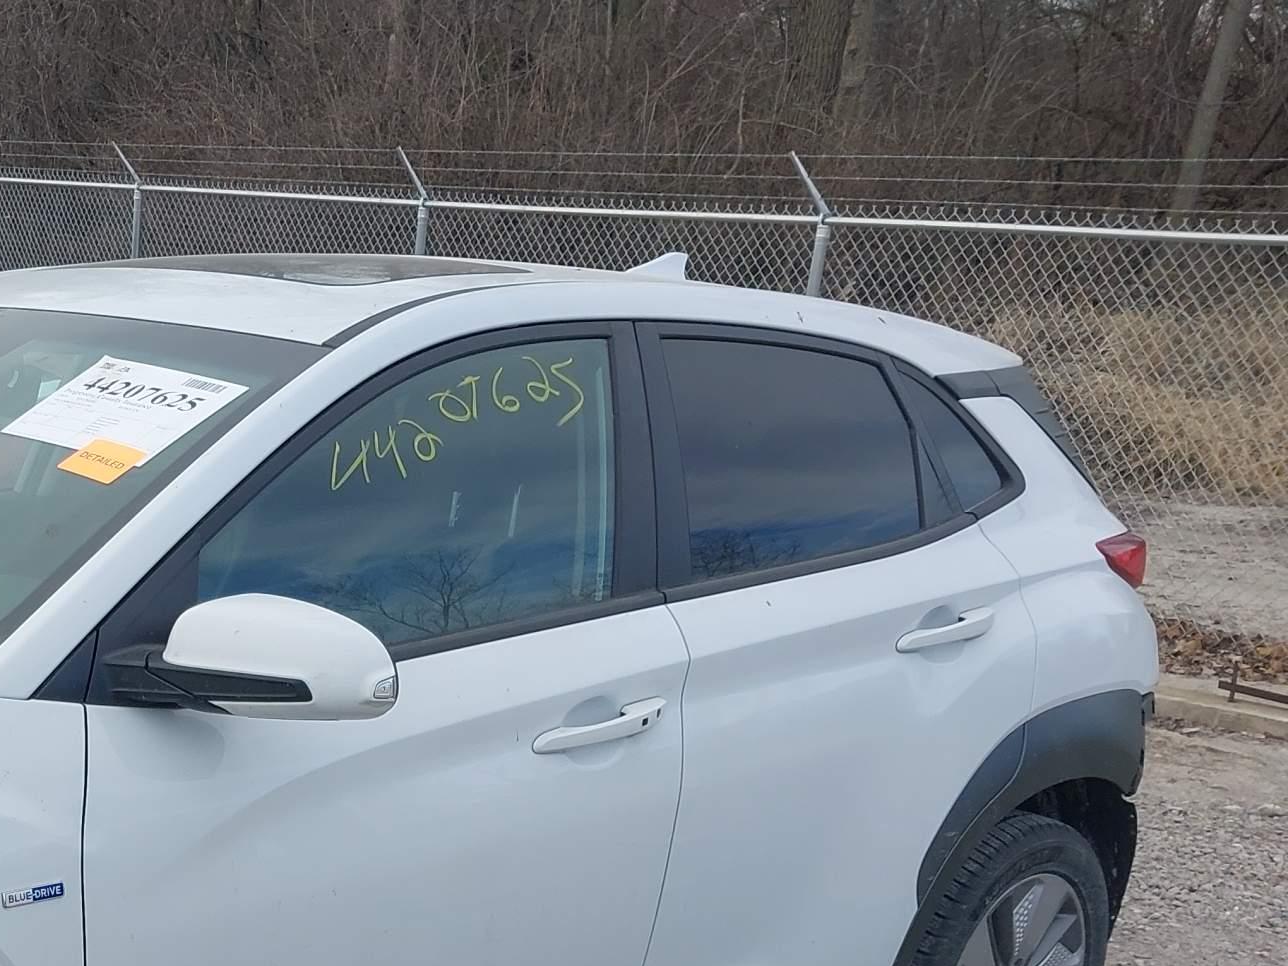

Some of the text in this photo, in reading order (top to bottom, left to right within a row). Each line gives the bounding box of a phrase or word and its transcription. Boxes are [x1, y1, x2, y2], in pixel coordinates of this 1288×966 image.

[83, 376, 206, 413] 44207625
[330, 356, 585, 491] 44207625
[79, 450, 125, 470] DETAILED
[34, 884, 63, 899] DRIVE
